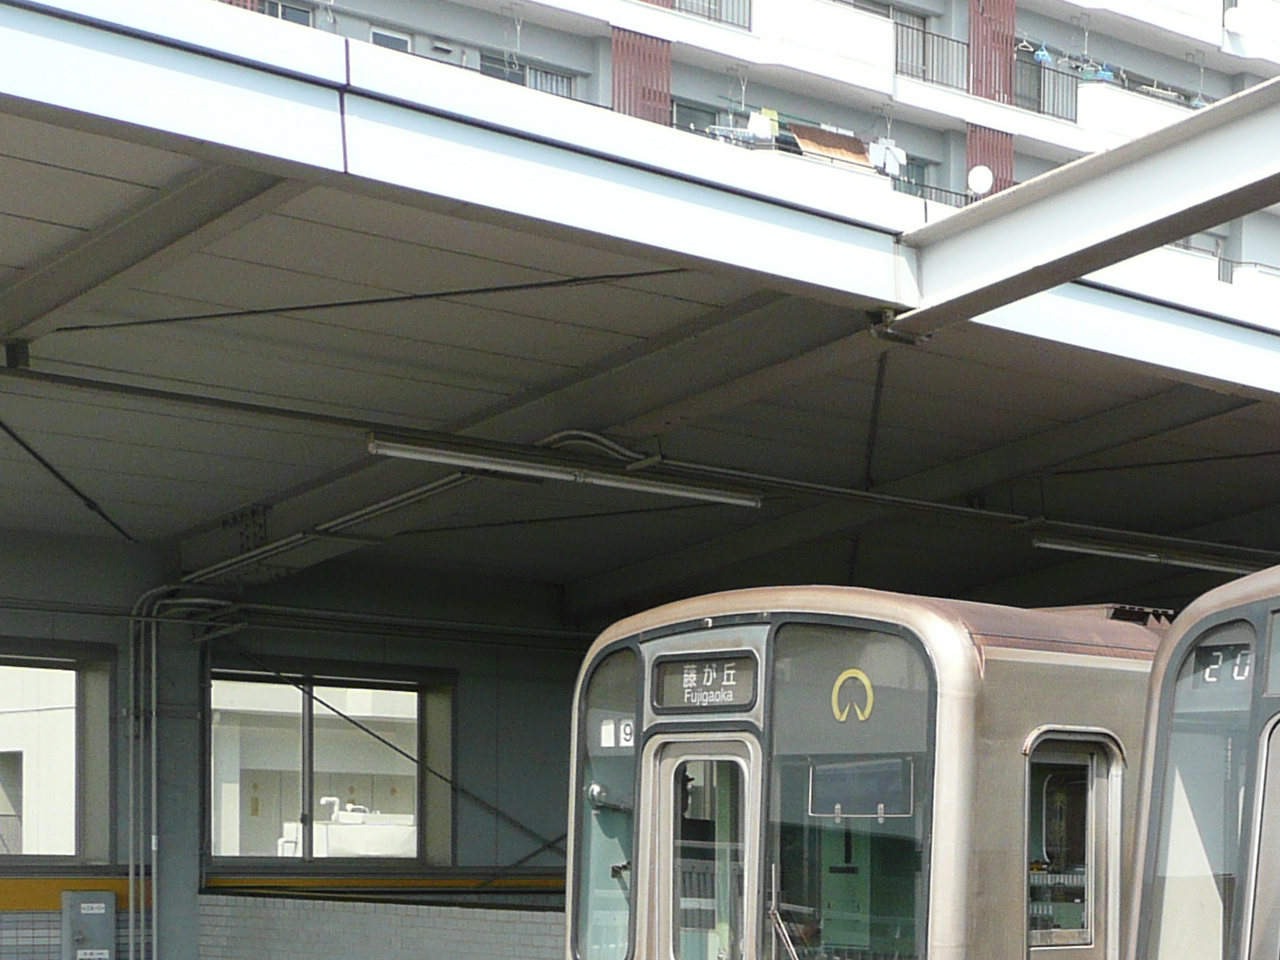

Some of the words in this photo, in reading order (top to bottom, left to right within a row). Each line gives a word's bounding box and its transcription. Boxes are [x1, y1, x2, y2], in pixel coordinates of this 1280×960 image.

[683, 662, 737, 688] 藤が丘
[1204, 650, 1251, 682] 20
[684, 688, 734, 706] Fujigaoka
[622, 723, 633, 742] 9
